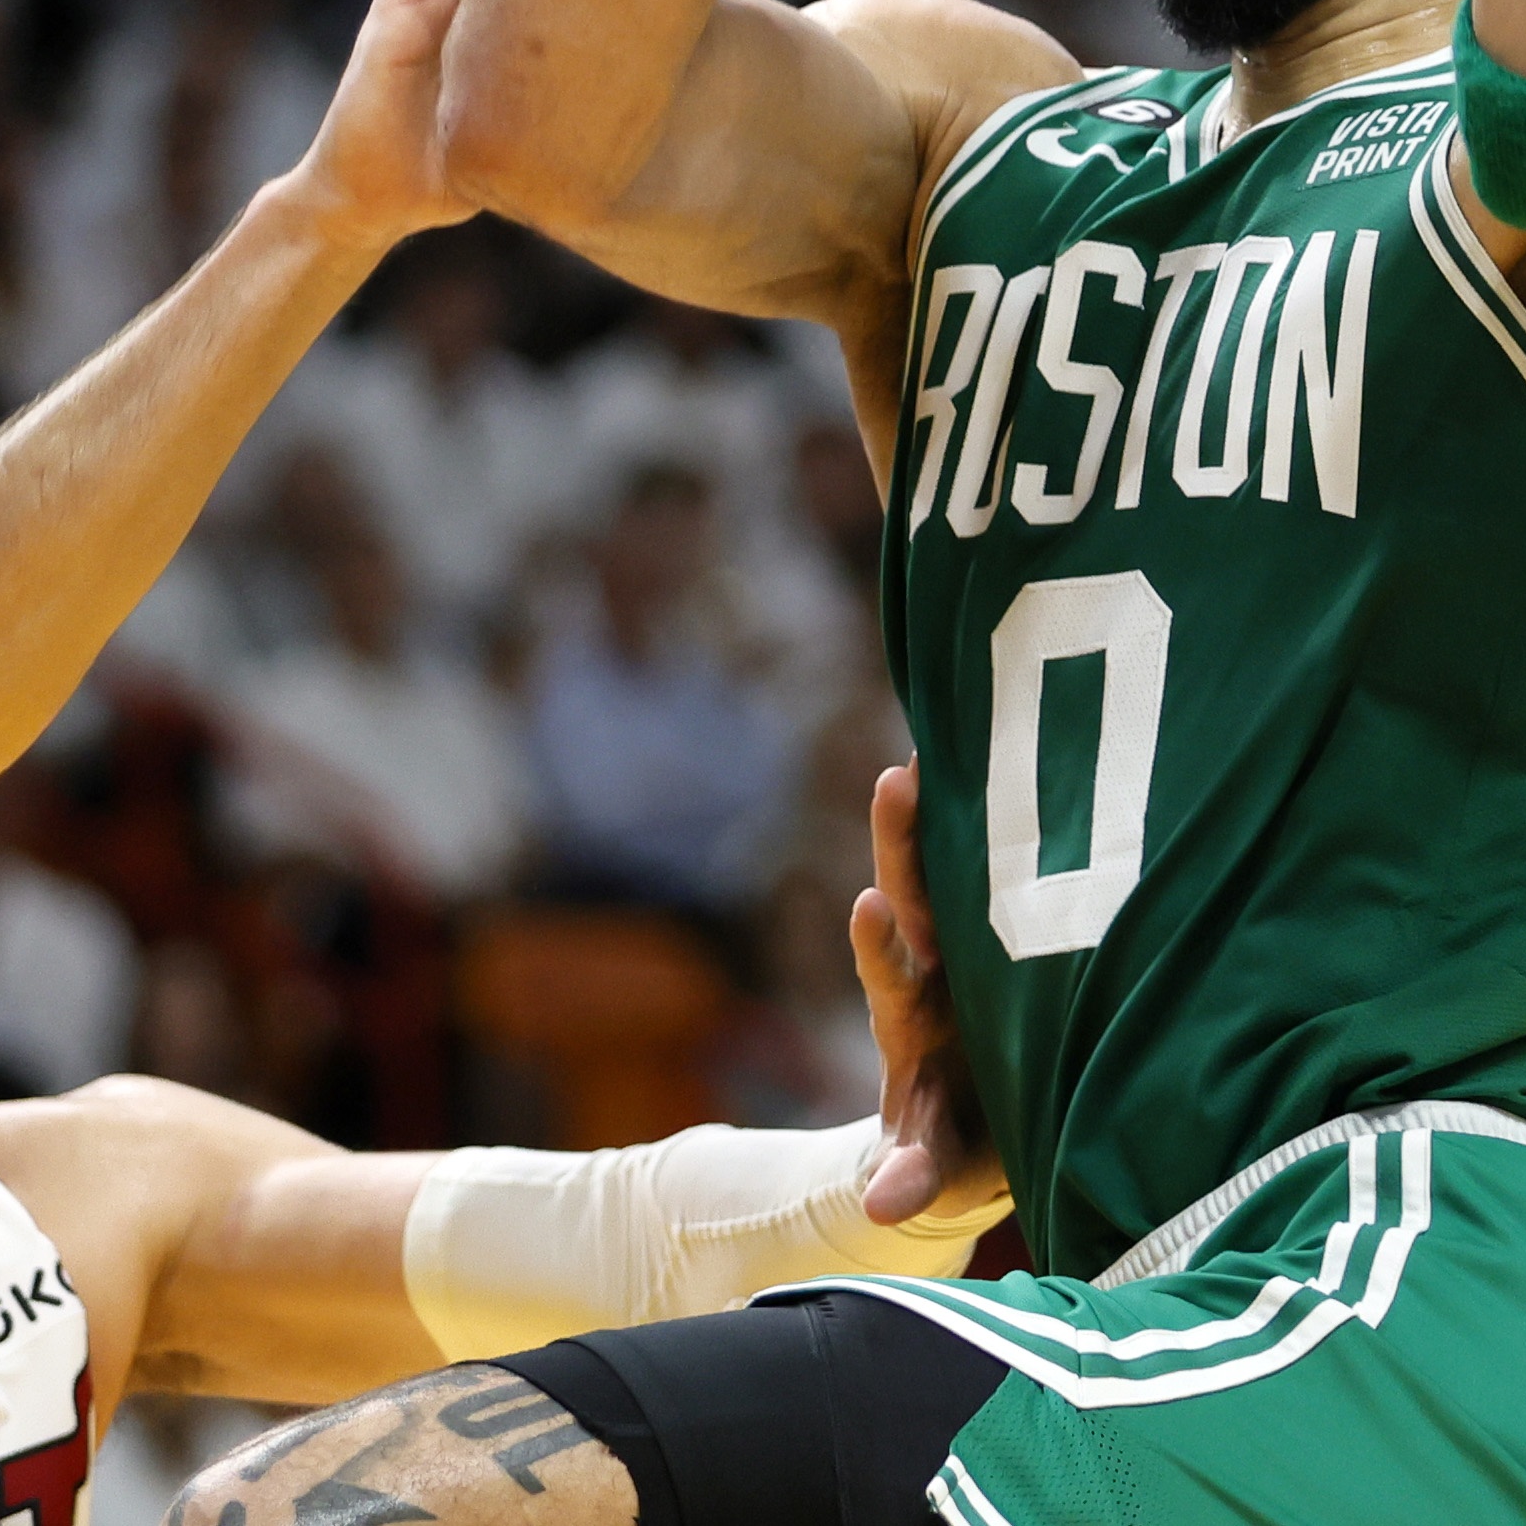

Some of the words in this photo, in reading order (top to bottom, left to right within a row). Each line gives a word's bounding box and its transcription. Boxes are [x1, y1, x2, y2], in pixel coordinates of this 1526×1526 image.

[1097, 98, 1174, 125] 6
[1328, 100, 1449, 148] VISTA
[1306, 136, 1427, 185] PRINT
[910, 229, 1379, 543] BOSTON
[986, 569, 1173, 962] 0
